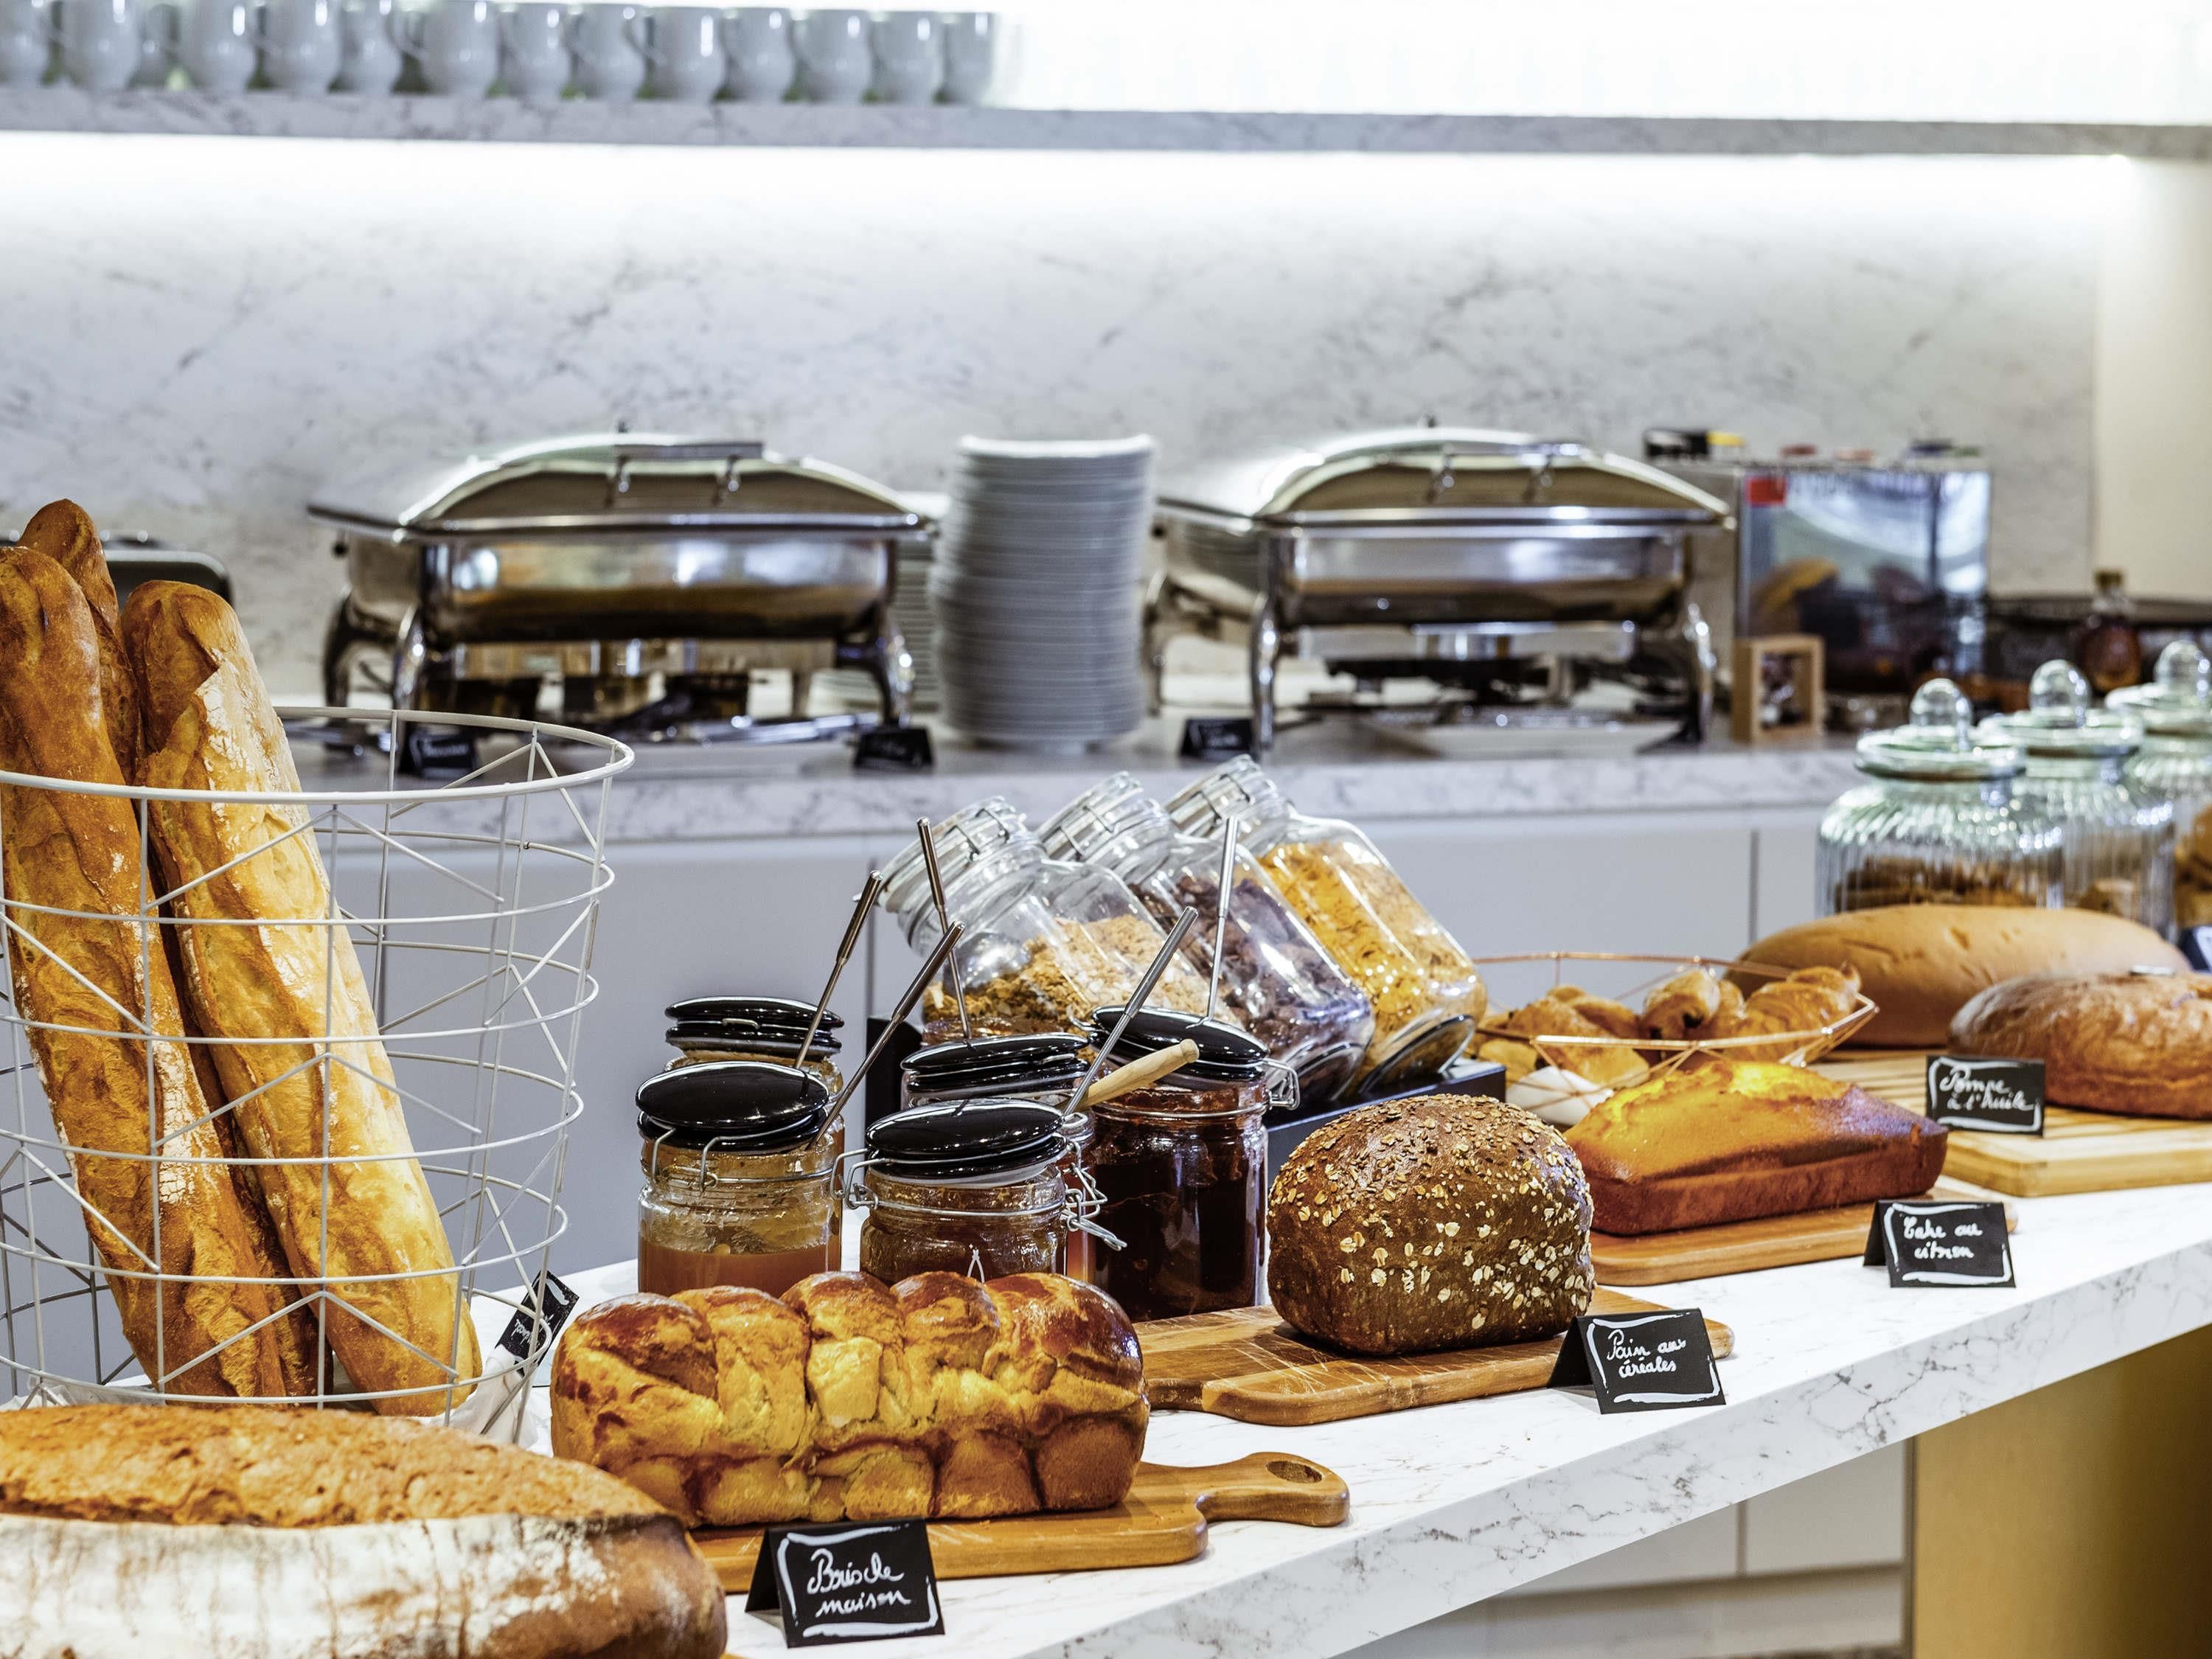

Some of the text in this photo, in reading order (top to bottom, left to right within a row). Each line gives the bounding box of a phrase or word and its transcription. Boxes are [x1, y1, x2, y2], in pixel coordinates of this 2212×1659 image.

[1954, 1222, 1983, 1237] au
[1913, 1240, 1975, 1260] citron
[1606, 1329, 1687, 1361] Pain aux
[1618, 1355, 1677, 1379] céréales
[815, 1590, 911, 1618] maison
